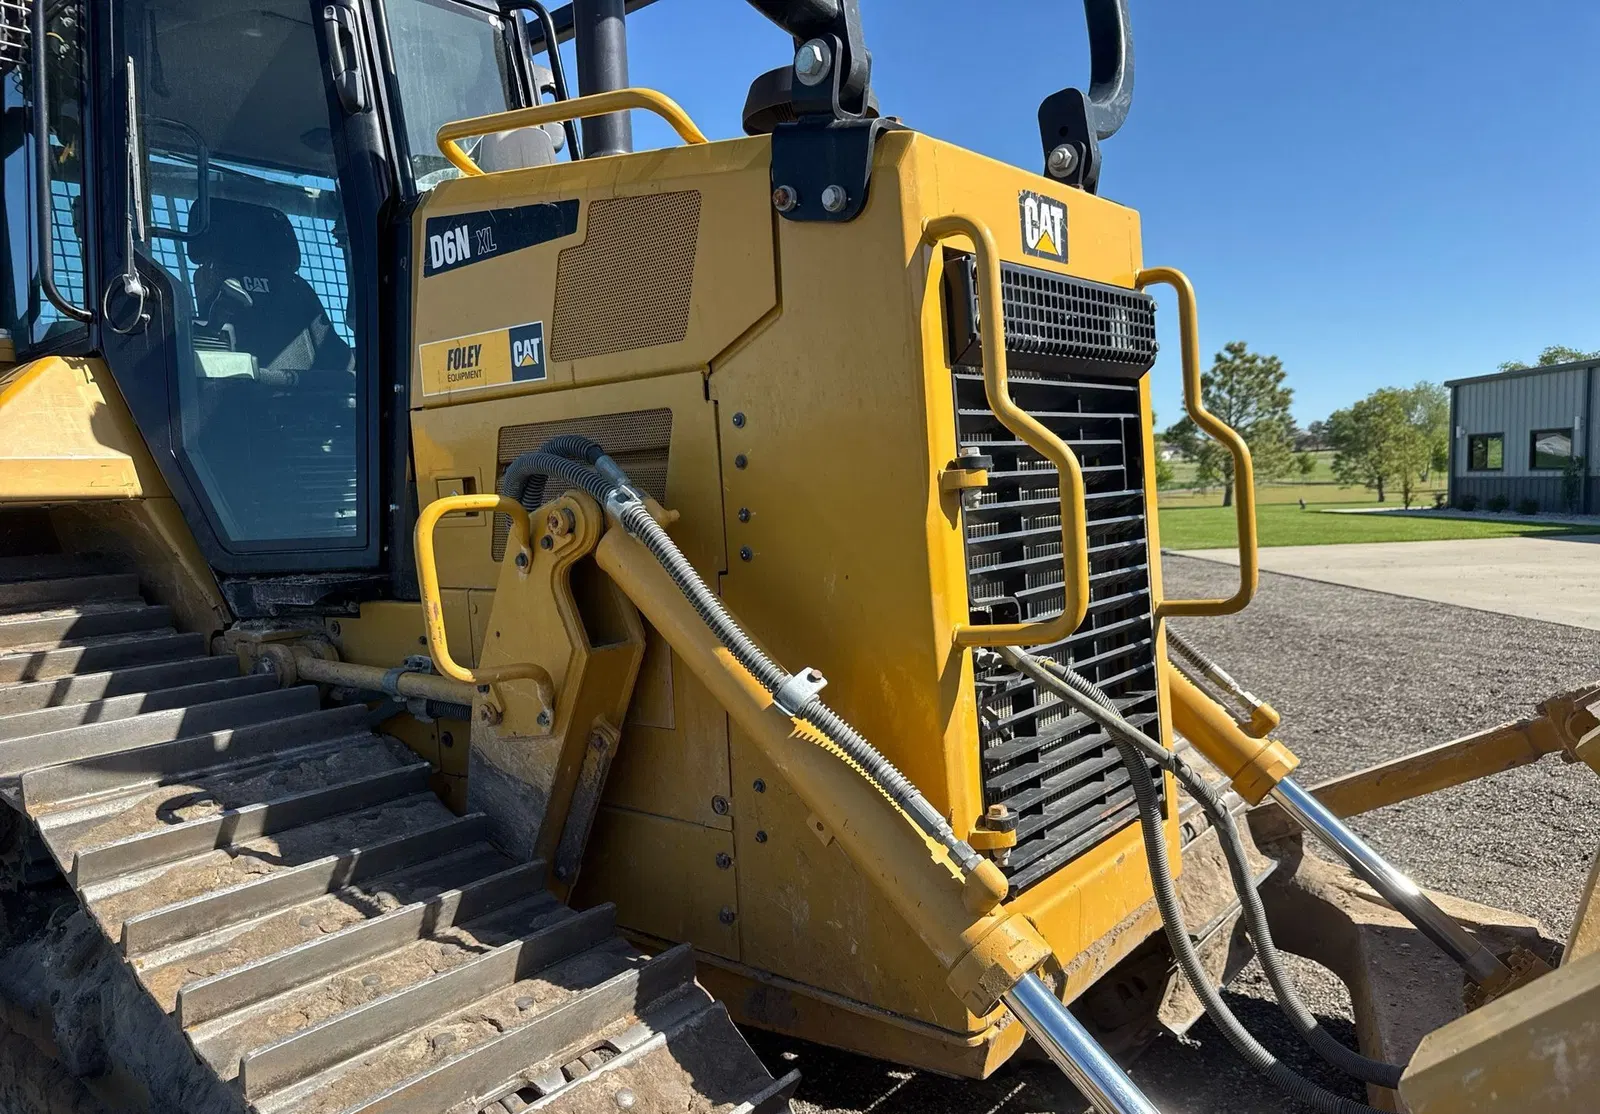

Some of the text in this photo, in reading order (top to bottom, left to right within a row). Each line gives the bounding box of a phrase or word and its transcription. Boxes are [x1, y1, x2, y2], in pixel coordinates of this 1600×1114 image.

[1025, 197, 1063, 257] CAT
[430, 225, 497, 269] D6N XL
[243, 276, 270, 293] CAT
[447, 344, 482, 371] FOLEY
[513, 338, 541, 367] CAT
[447, 369, 482, 383] EQUIPMENT
